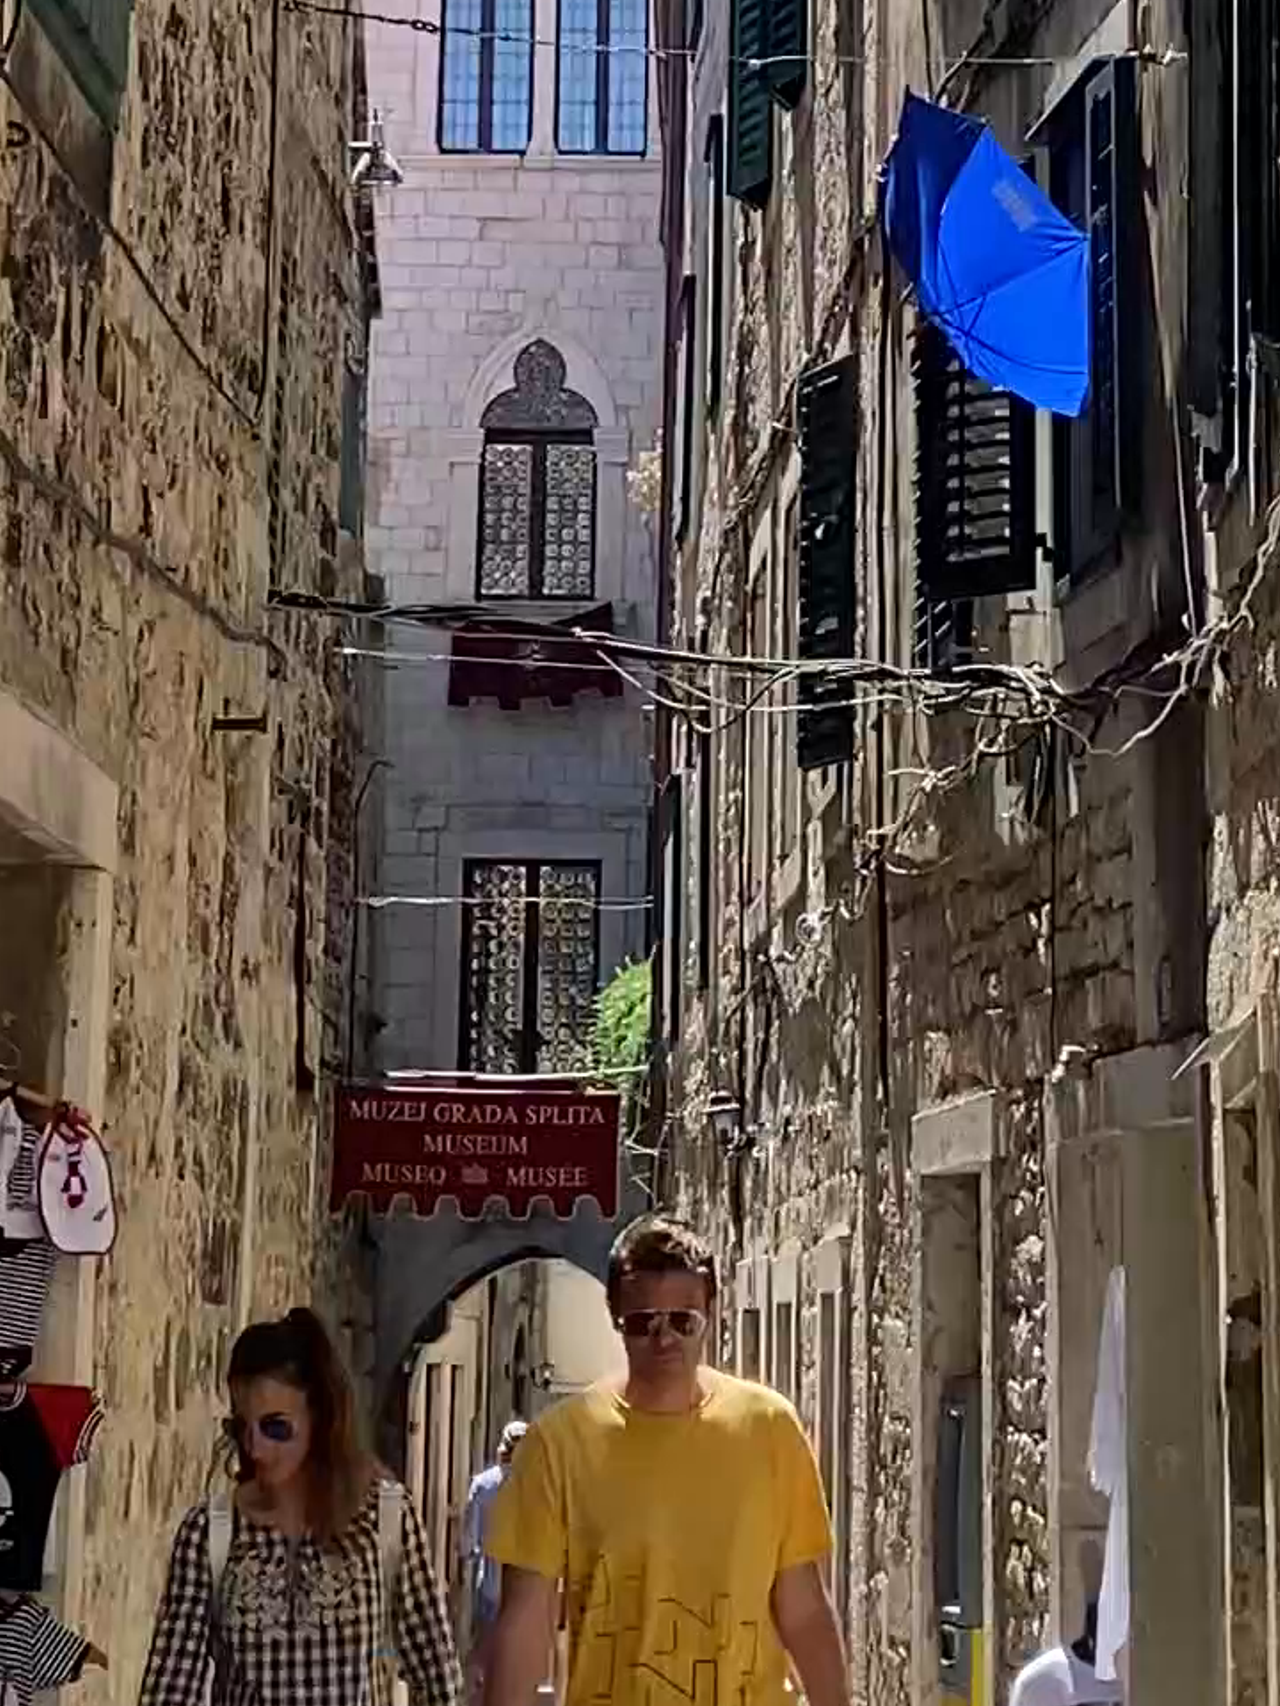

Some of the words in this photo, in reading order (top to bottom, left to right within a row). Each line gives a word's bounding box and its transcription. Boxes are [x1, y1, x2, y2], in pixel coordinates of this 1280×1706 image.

[350, 1099, 427, 1122] MUZEJ
[433, 1102, 519, 1124] GRADA
[525, 1105, 605, 1125] SPLITA
[423, 1134, 528, 1155] MUSEUM
[361, 1162, 447, 1185] MUSEO
